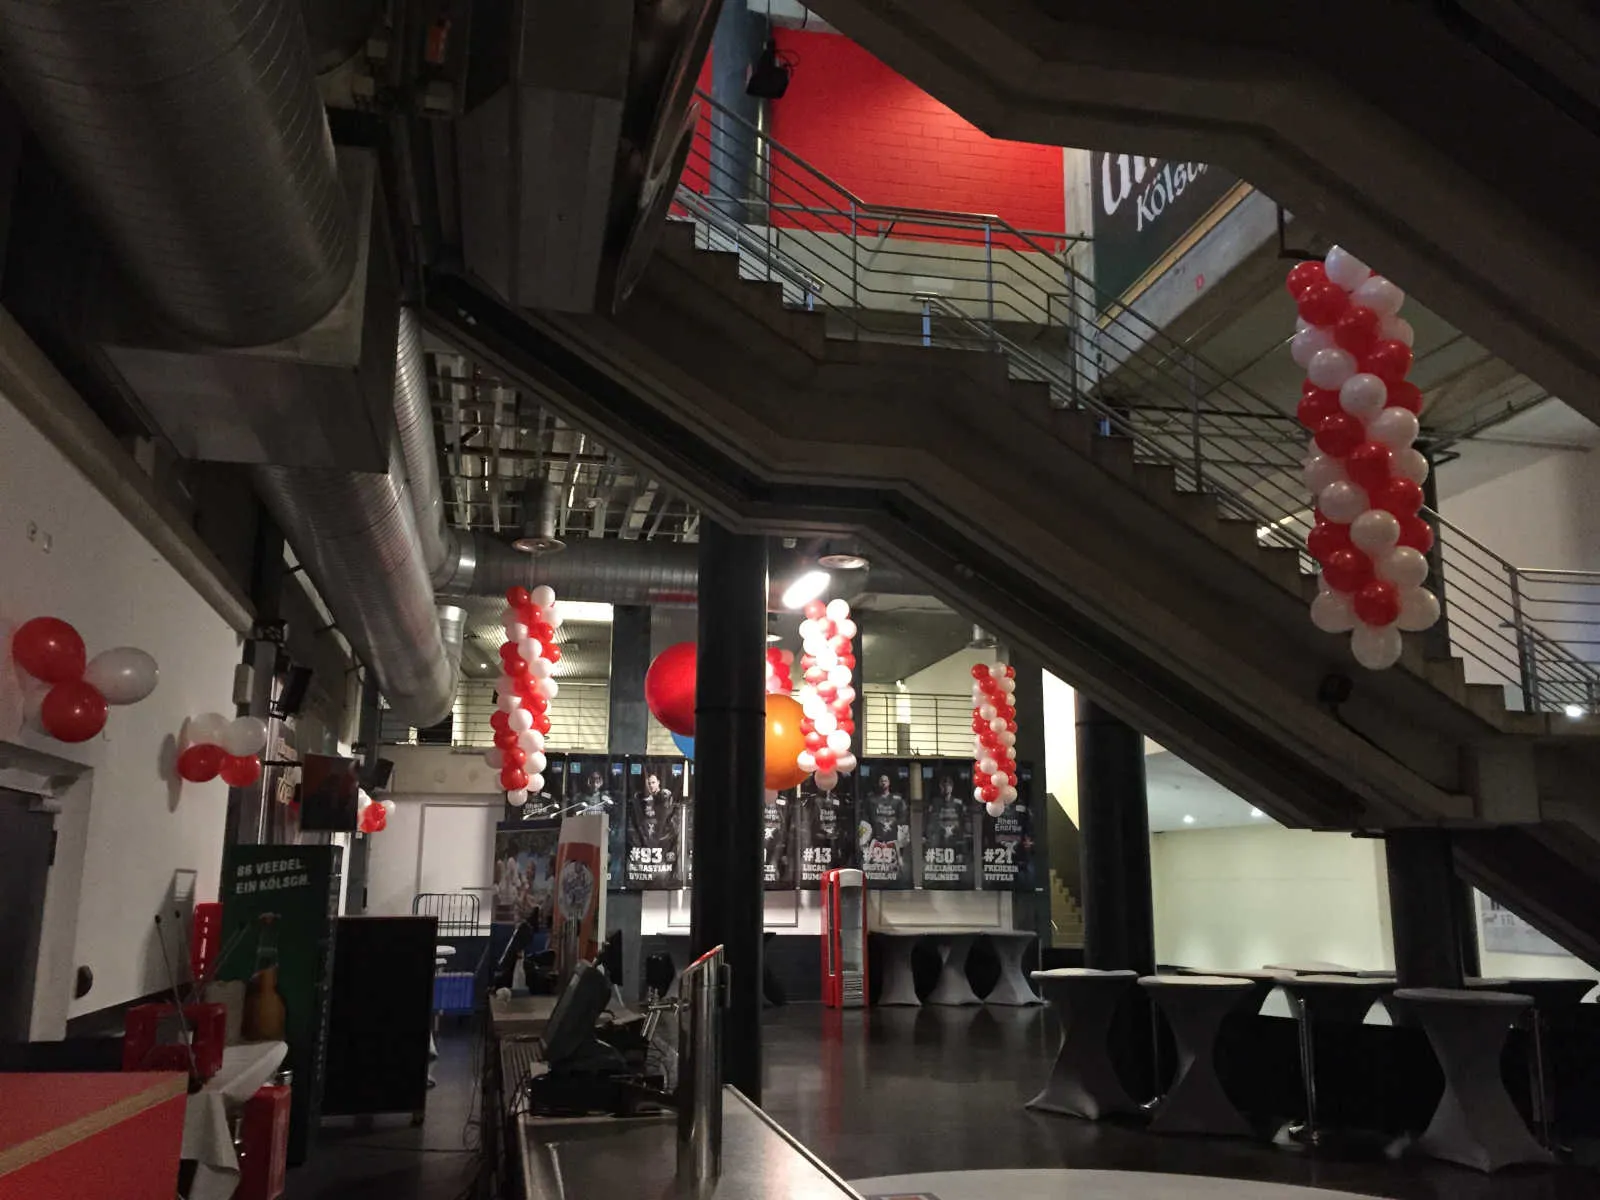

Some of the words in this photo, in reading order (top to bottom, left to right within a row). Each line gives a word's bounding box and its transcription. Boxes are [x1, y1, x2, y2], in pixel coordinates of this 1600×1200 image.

[1136, 161, 1208, 232] Kölsc
[629, 847, 663, 863] #93
[802, 847, 832, 863] #13
[925, 847, 955, 863] #50
[983, 847, 1013, 864] #21
[236, 880, 257, 894] EIN
